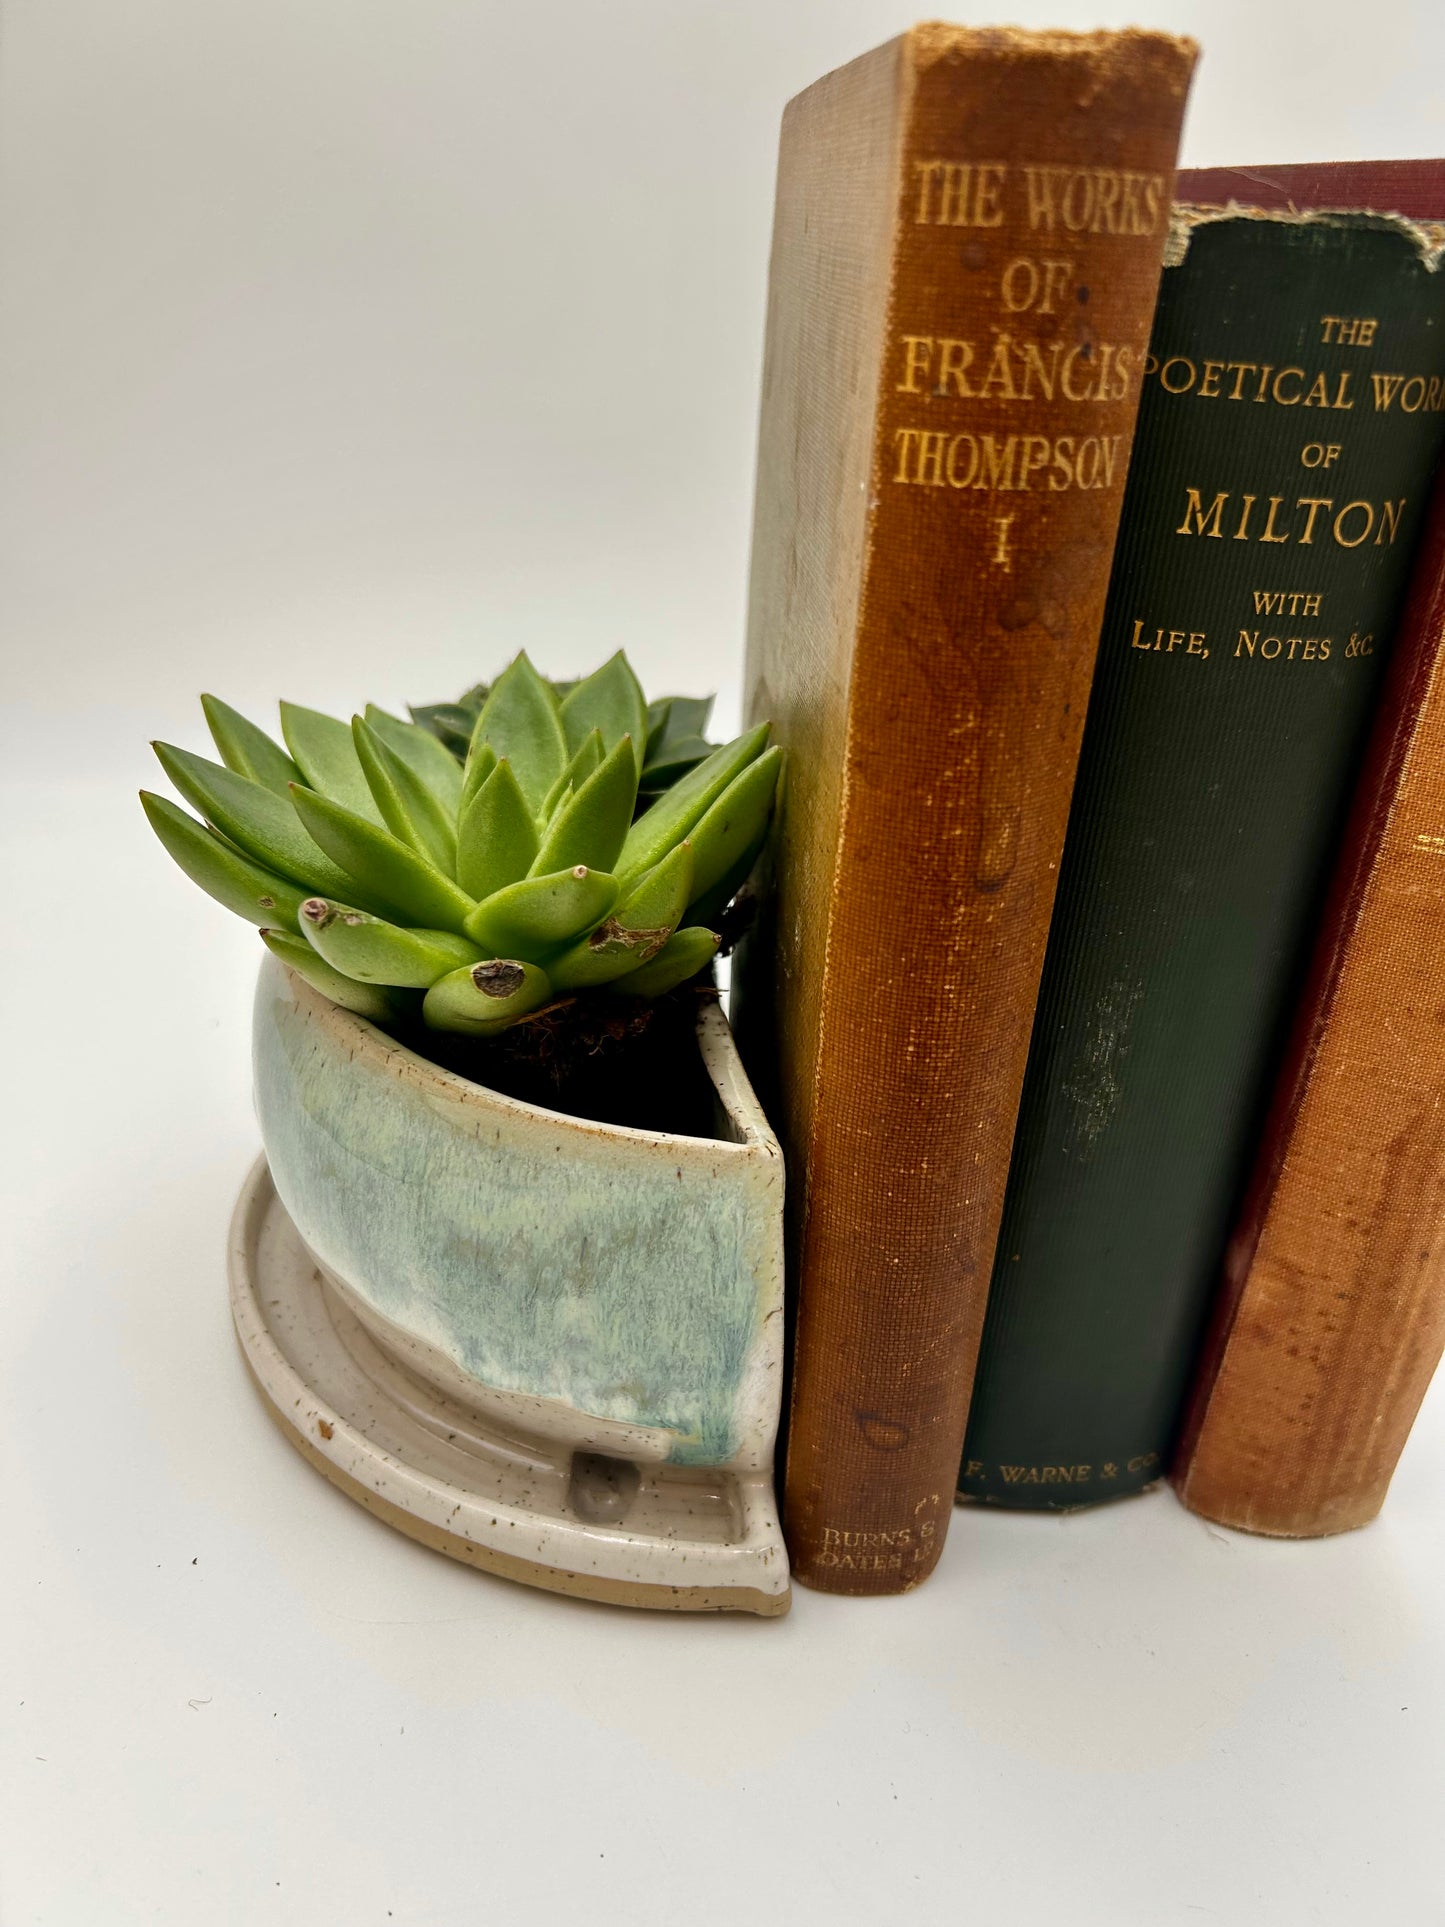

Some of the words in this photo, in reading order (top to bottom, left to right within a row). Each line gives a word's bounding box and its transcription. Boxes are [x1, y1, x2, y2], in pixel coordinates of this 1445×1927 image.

[914, 160, 1006, 227] THE
[1023, 167, 1166, 235] WORKS
[1002, 257, 1073, 314] OF
[1320, 315, 1379, 347] THE
[896, 334, 1133, 402] FRANCIS
[893, 428, 1123, 492] THOMPSON
[1301, 443, 1342, 469] OF
[1176, 488, 1406, 548] MILTON
[1253, 591, 1323, 617] WITH
[999, 1464, 1091, 1484] WARNE
[1101, 1462, 1119, 1478] &
[823, 1527, 912, 1548] BURNS
